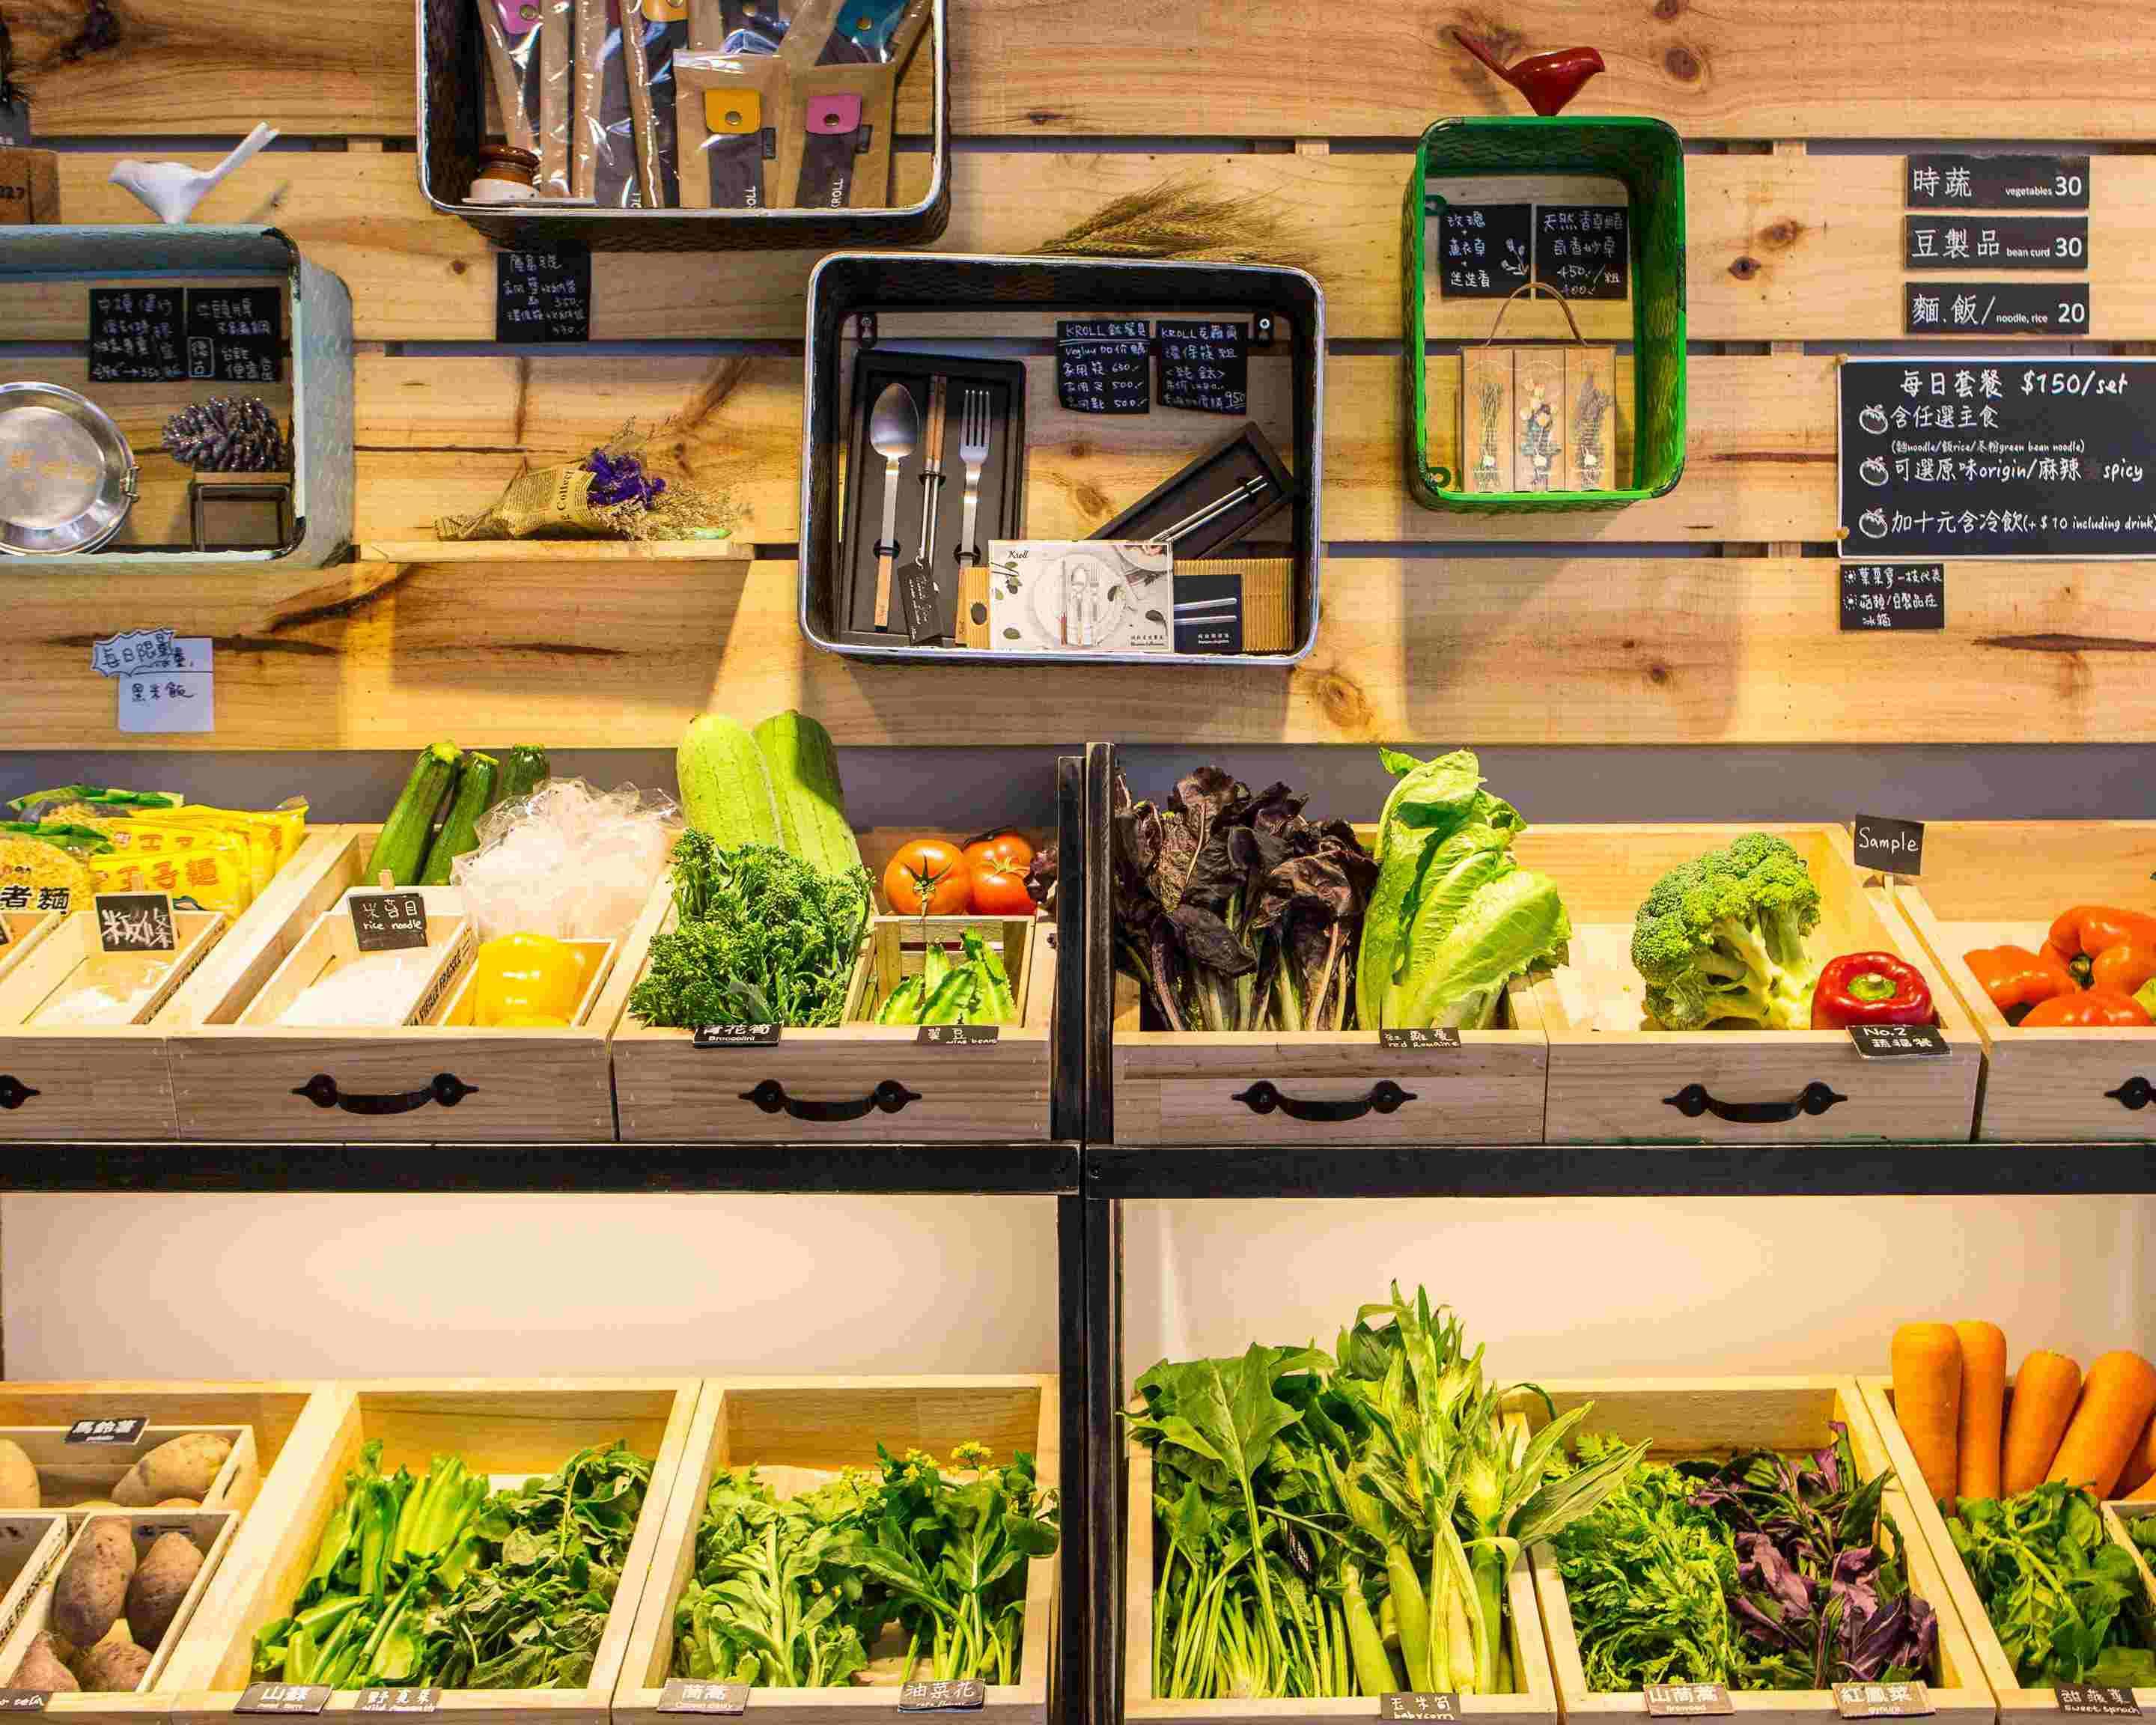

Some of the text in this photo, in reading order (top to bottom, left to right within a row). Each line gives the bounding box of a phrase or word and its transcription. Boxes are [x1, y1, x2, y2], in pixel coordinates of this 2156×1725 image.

[1913, 167, 2082, 198] 時蔬 vegetables 30
[1911, 228, 2082, 258] 豆製品 bean curd 30
[2031, 314, 2047, 323] rice
[2058, 303, 2085, 323] 20
[1066, 323, 1105, 336] KROLL
[1900, 370, 2128, 398] 每日套餐 $150/set
[1890, 405, 1999, 428] 含任選主食
[2028, 440, 2049, 452] bean
[2103, 458, 2143, 482] spicy
[2072, 515, 2120, 532] including
[1859, 827, 1919, 854] Sample
[363, 919, 423, 930] rice noodle
[1863, 1027, 1907, 1036] No.2
[904, 1681, 975, 1699] 油菜花
[1390, 1695, 1450, 1712] 玉米筍
